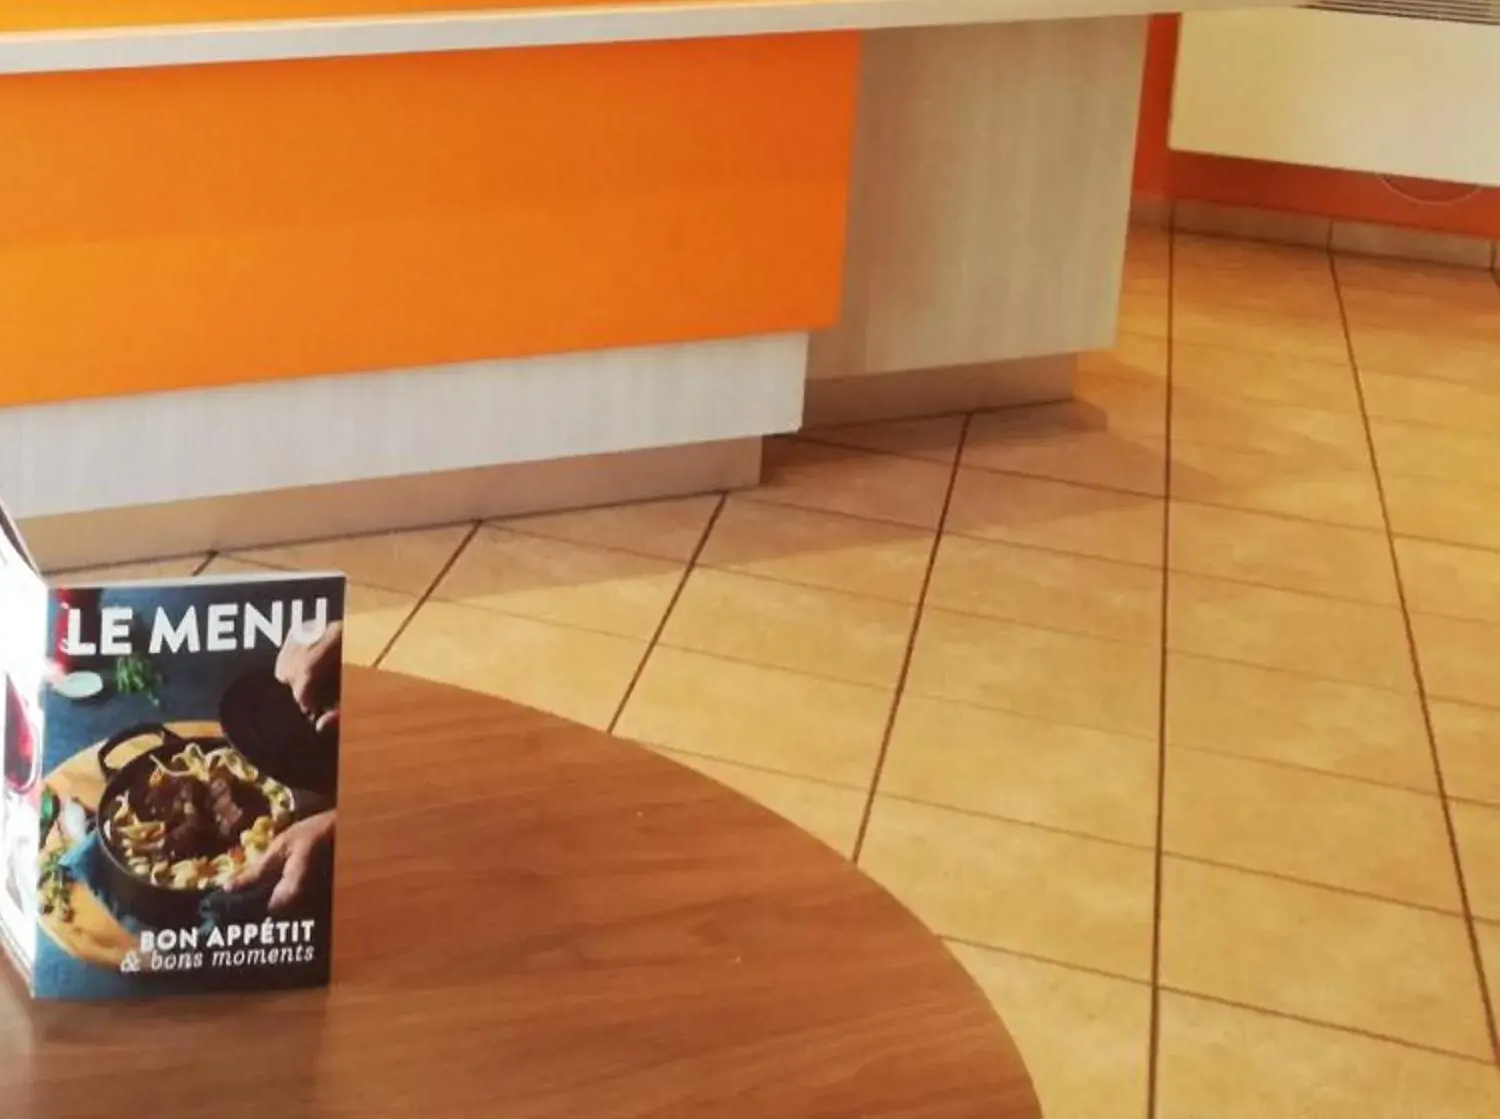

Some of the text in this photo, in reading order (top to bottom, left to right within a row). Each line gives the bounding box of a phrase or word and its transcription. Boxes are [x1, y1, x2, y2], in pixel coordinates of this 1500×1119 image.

[67, 597, 329, 656] LE MENU
[139, 917, 316, 953] BON APPÉTIT
[119, 944, 316, 973] & bons moments
